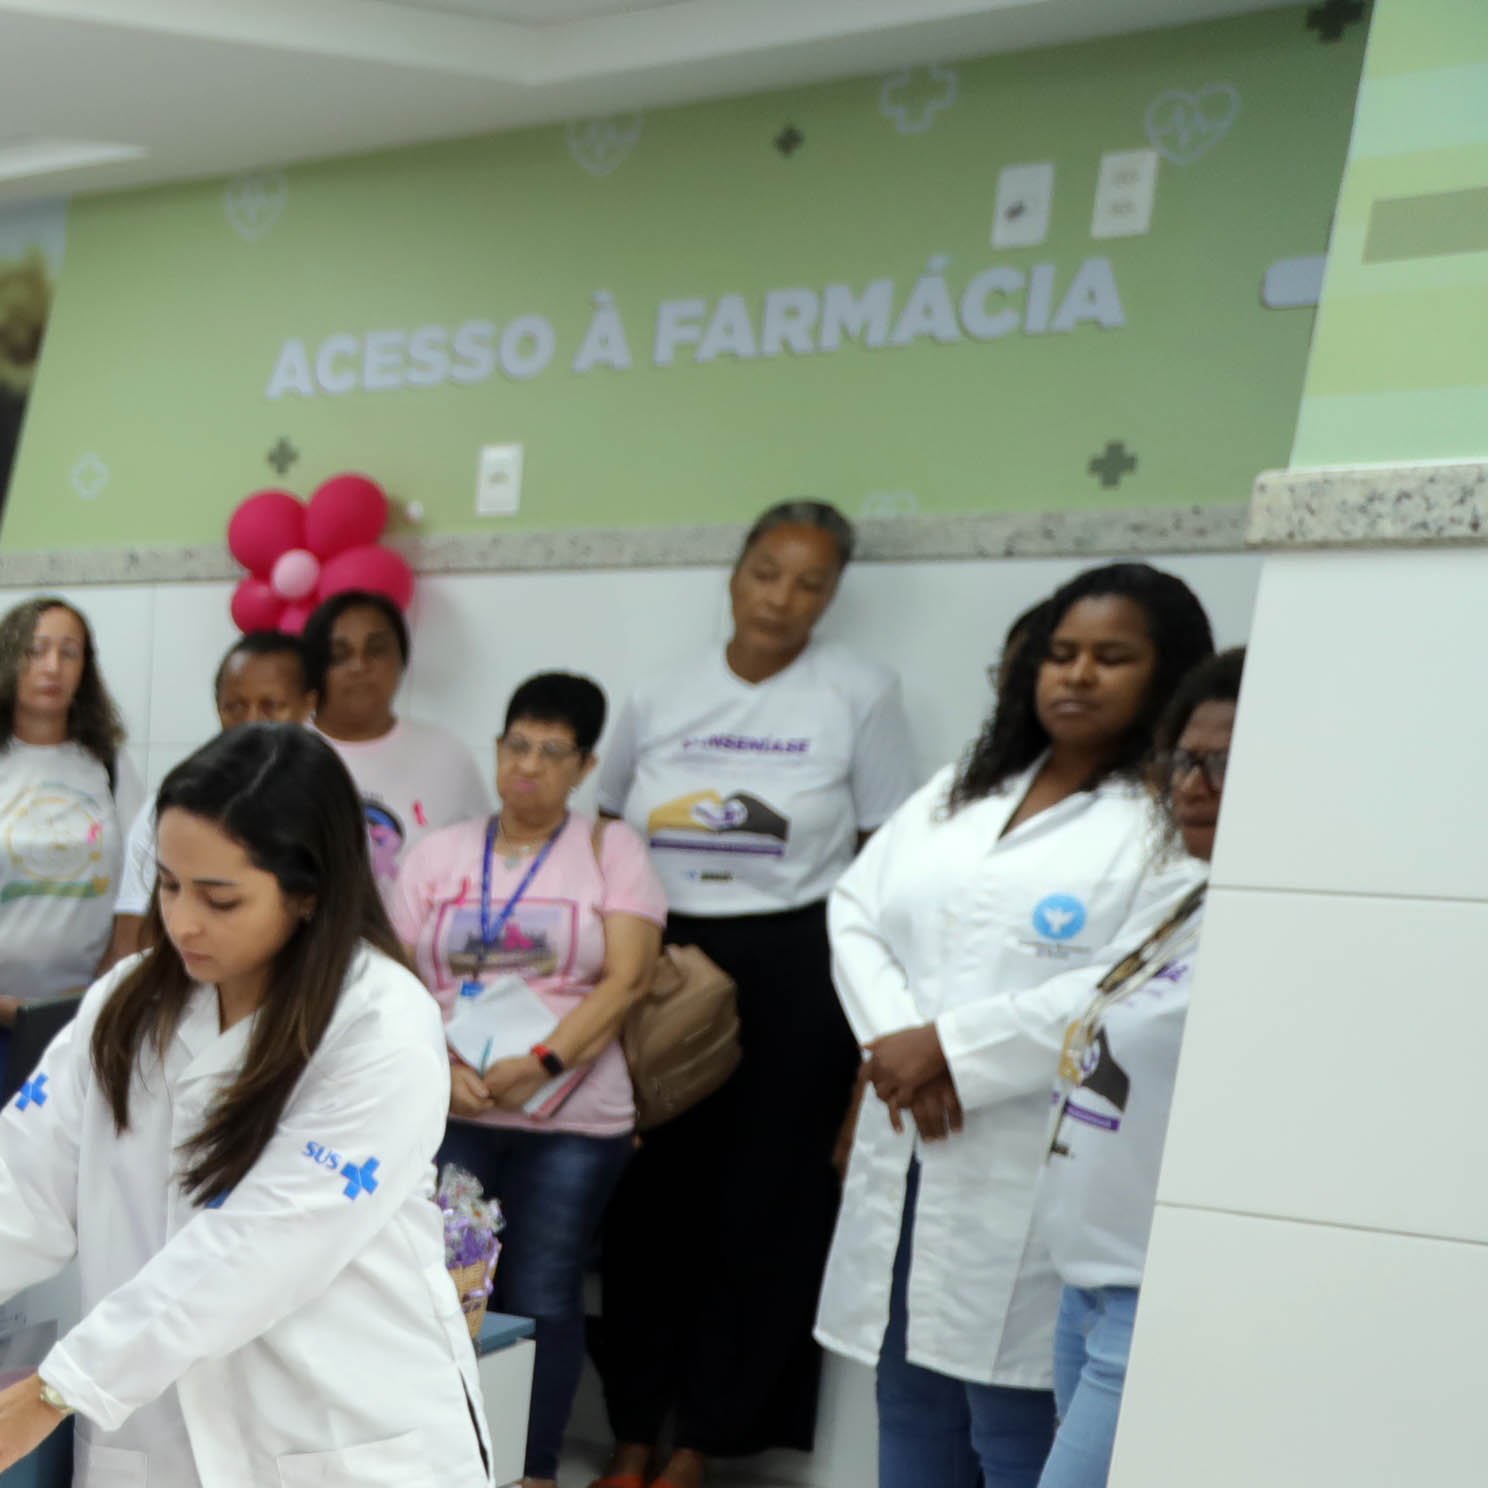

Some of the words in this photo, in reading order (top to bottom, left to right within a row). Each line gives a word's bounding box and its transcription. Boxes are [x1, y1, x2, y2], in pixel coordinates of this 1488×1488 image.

[265, 313, 556, 401] ACESSO
[571, 291, 634, 374] À
[653, 256, 1129, 367] FARMÁCIA
[302, 1141, 341, 1170] SUS
